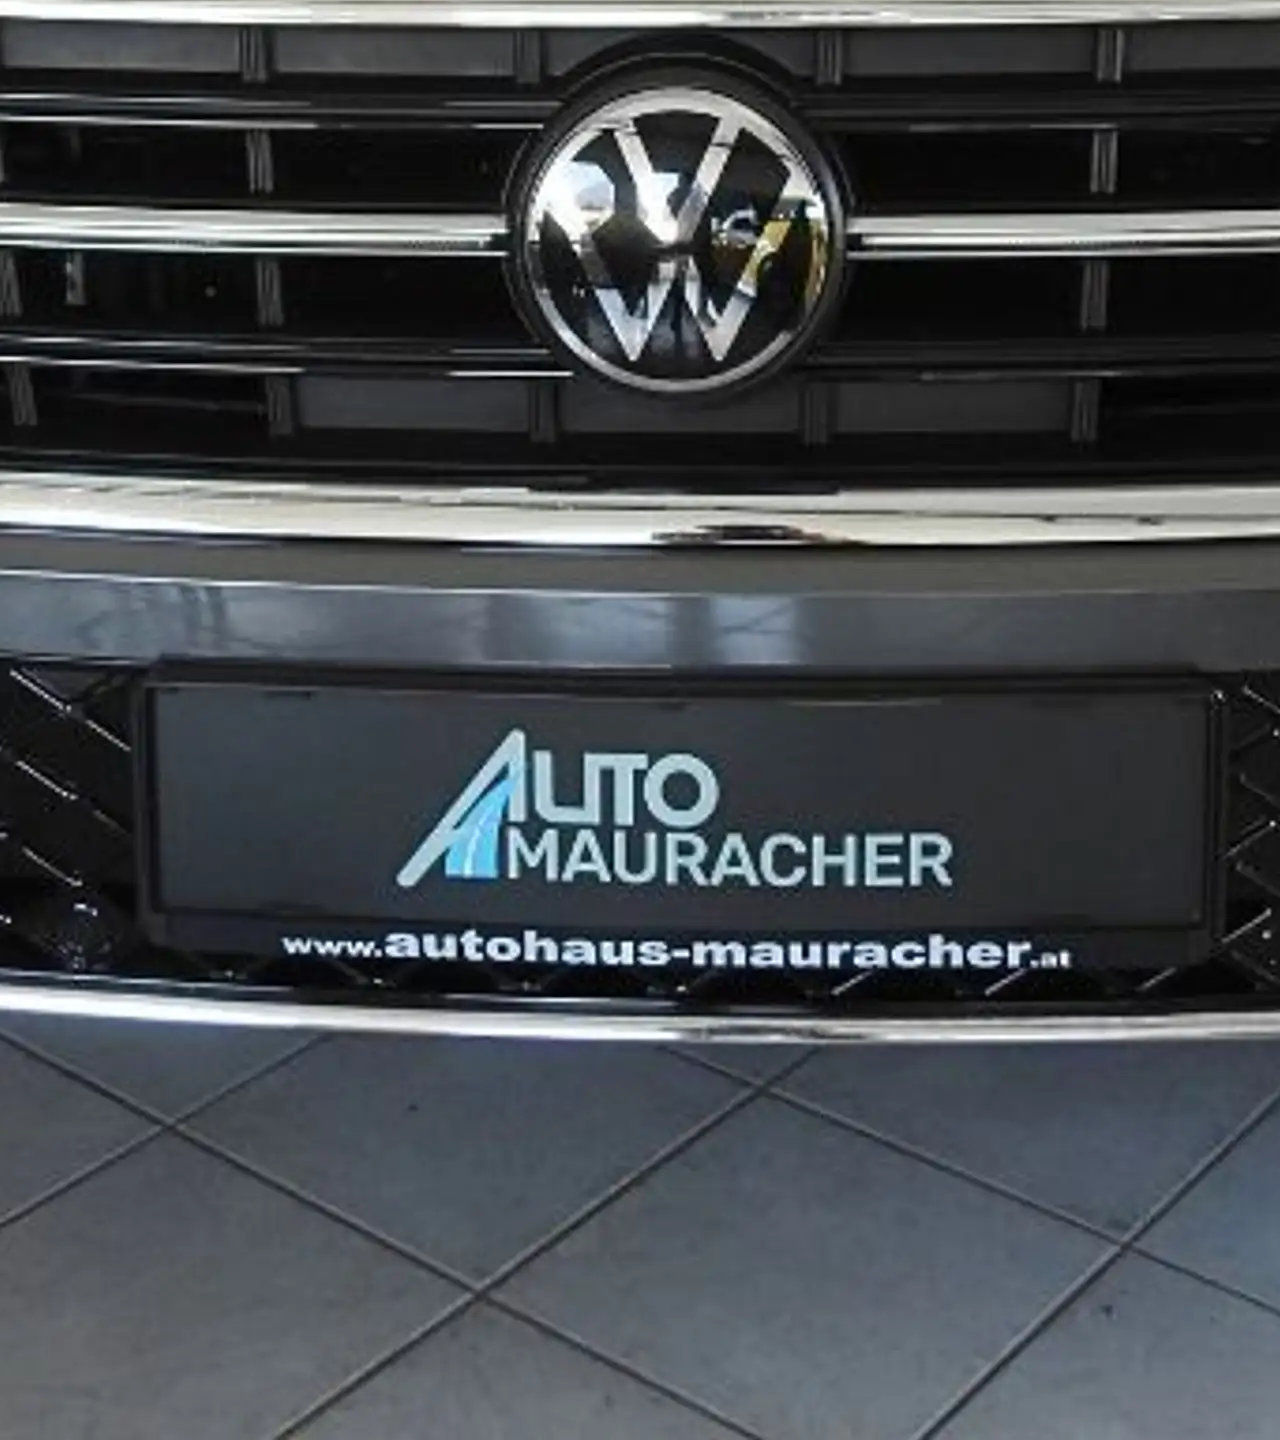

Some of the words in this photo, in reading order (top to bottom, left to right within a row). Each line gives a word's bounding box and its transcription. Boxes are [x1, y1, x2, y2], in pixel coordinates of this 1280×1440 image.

[397, 728, 719, 887] AUTO
[506, 828, 953, 887] MAURACHER
[281, 929, 1071, 968] www.autohaus-mauracher.at
